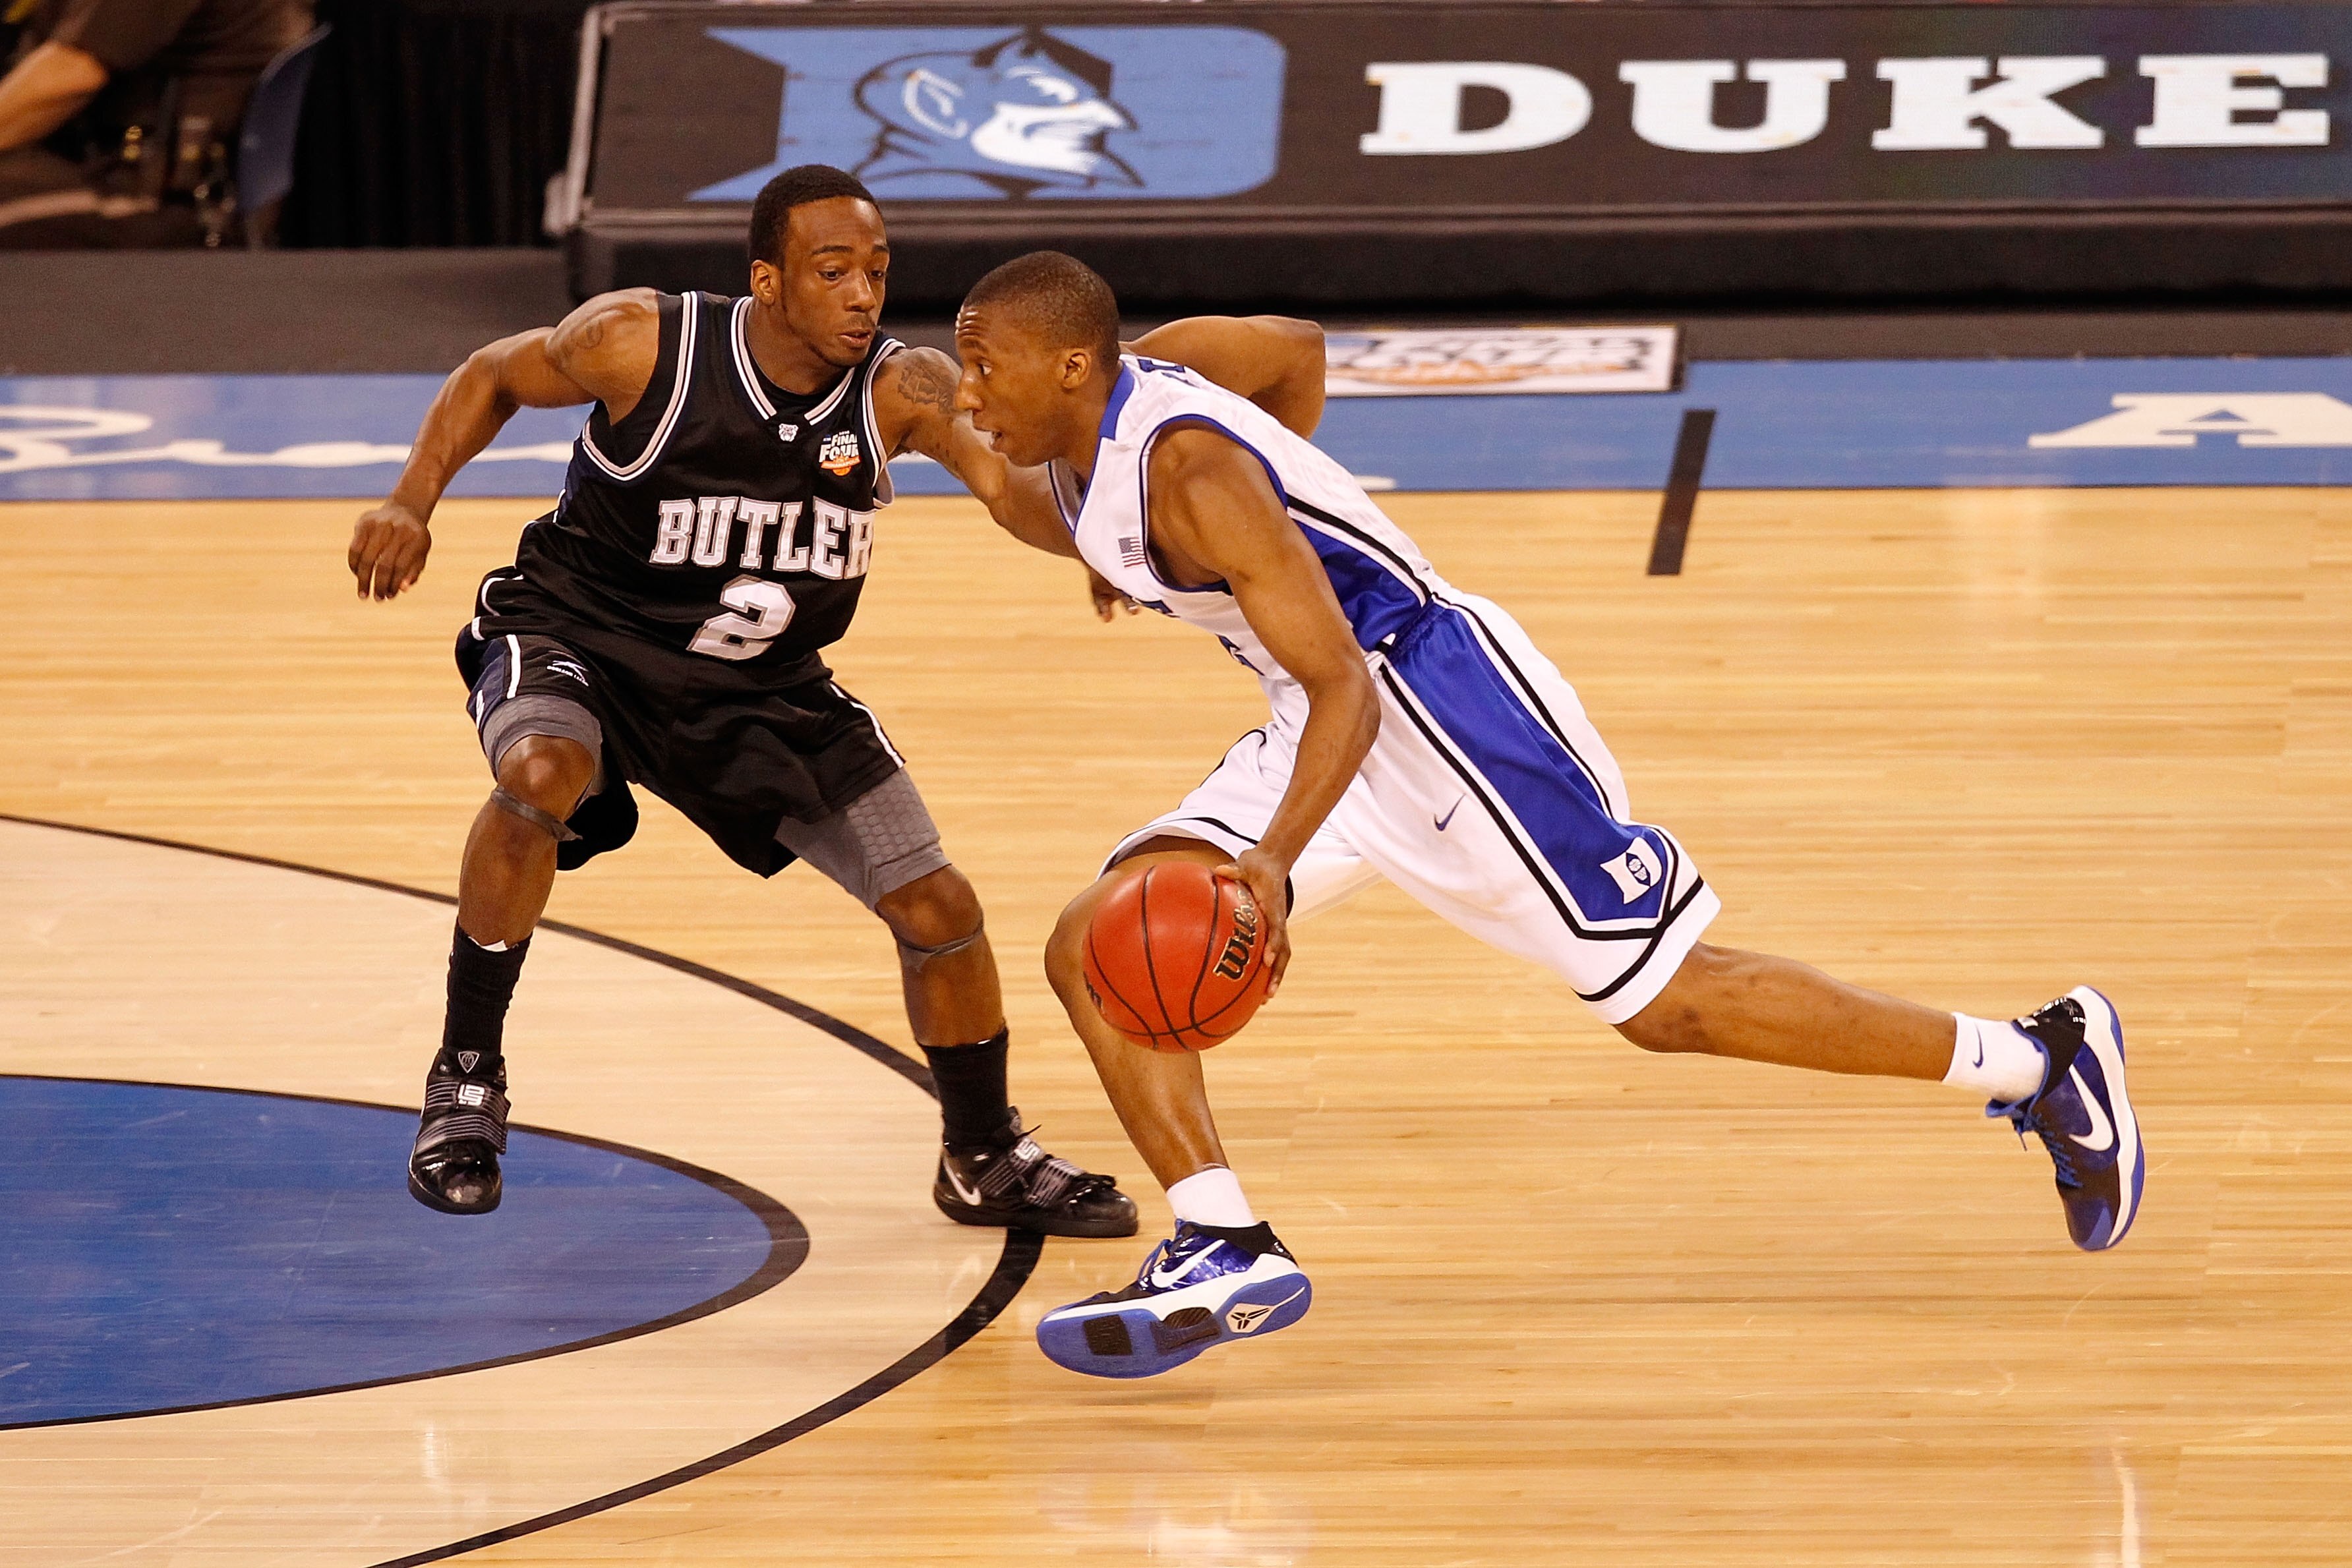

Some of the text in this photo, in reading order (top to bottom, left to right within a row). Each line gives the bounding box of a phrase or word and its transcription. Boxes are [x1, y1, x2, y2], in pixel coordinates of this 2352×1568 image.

[1360, 54, 2330, 156] DUKE
[649, 495, 875, 581] BUTLER
[686, 573, 796, 660] 2
